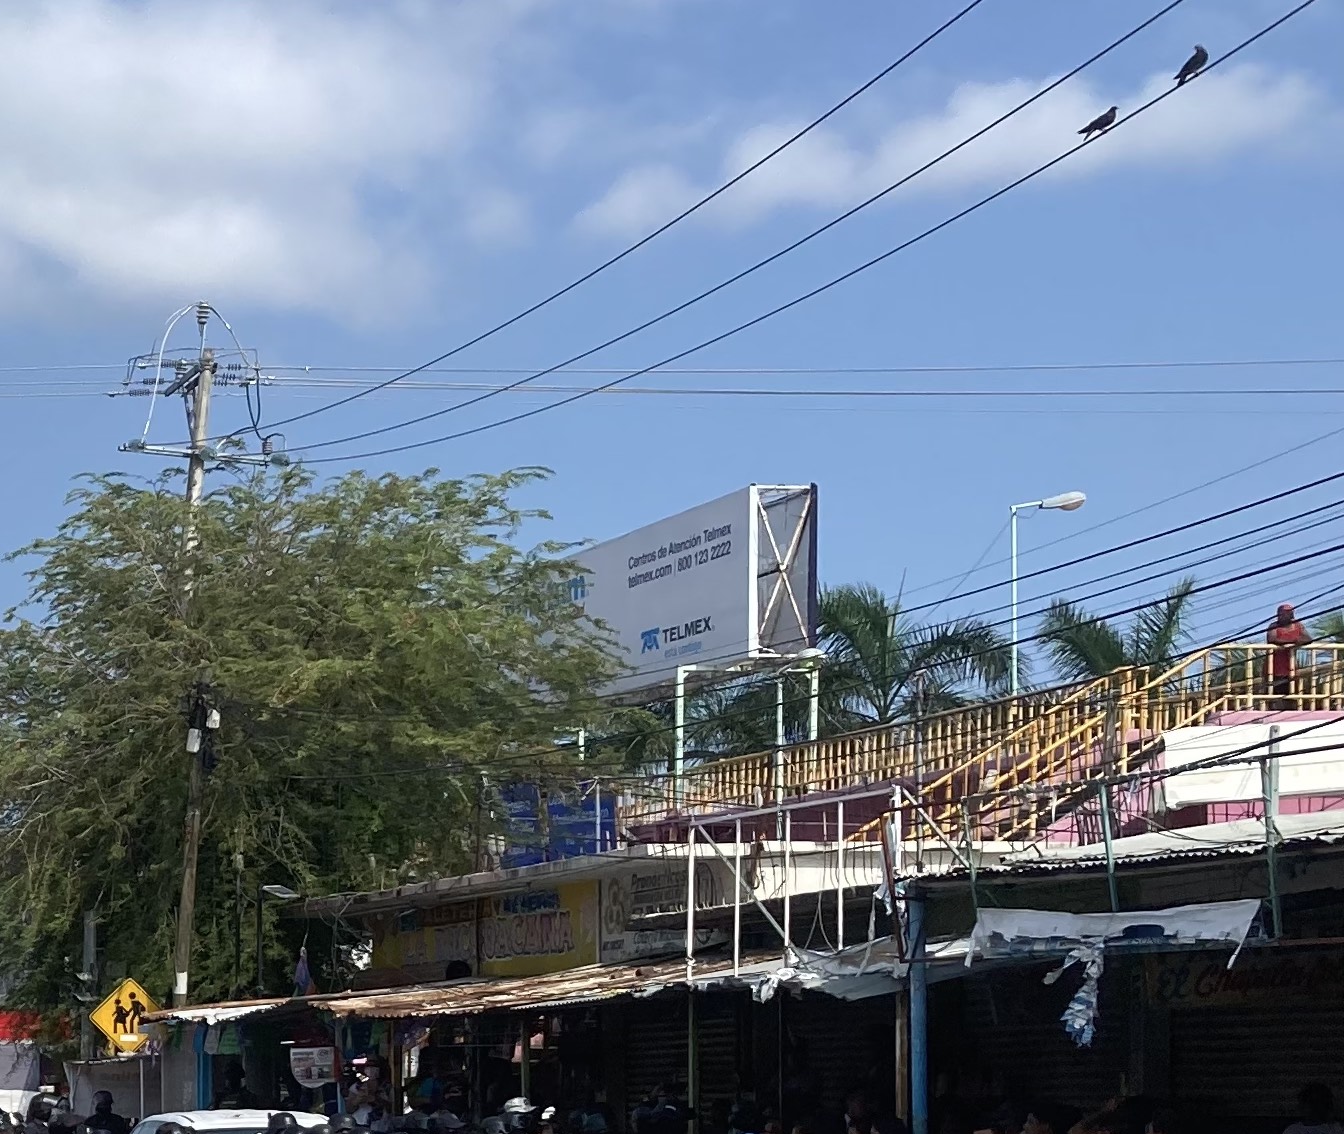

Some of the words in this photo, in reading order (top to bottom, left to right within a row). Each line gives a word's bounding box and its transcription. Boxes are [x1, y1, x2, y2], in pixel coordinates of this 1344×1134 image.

[628, 550, 657, 570] Centros
[657, 545, 668, 559] de
[668, 534, 702, 556] Atención
[703, 524, 732, 543] Telmex
[628, 563, 672, 588] telmex.com
[677, 556, 693, 572] 800
[694, 549, 709, 566] 123
[710, 540, 732, 560] 2222
[662, 616, 712, 643] TELMEX
